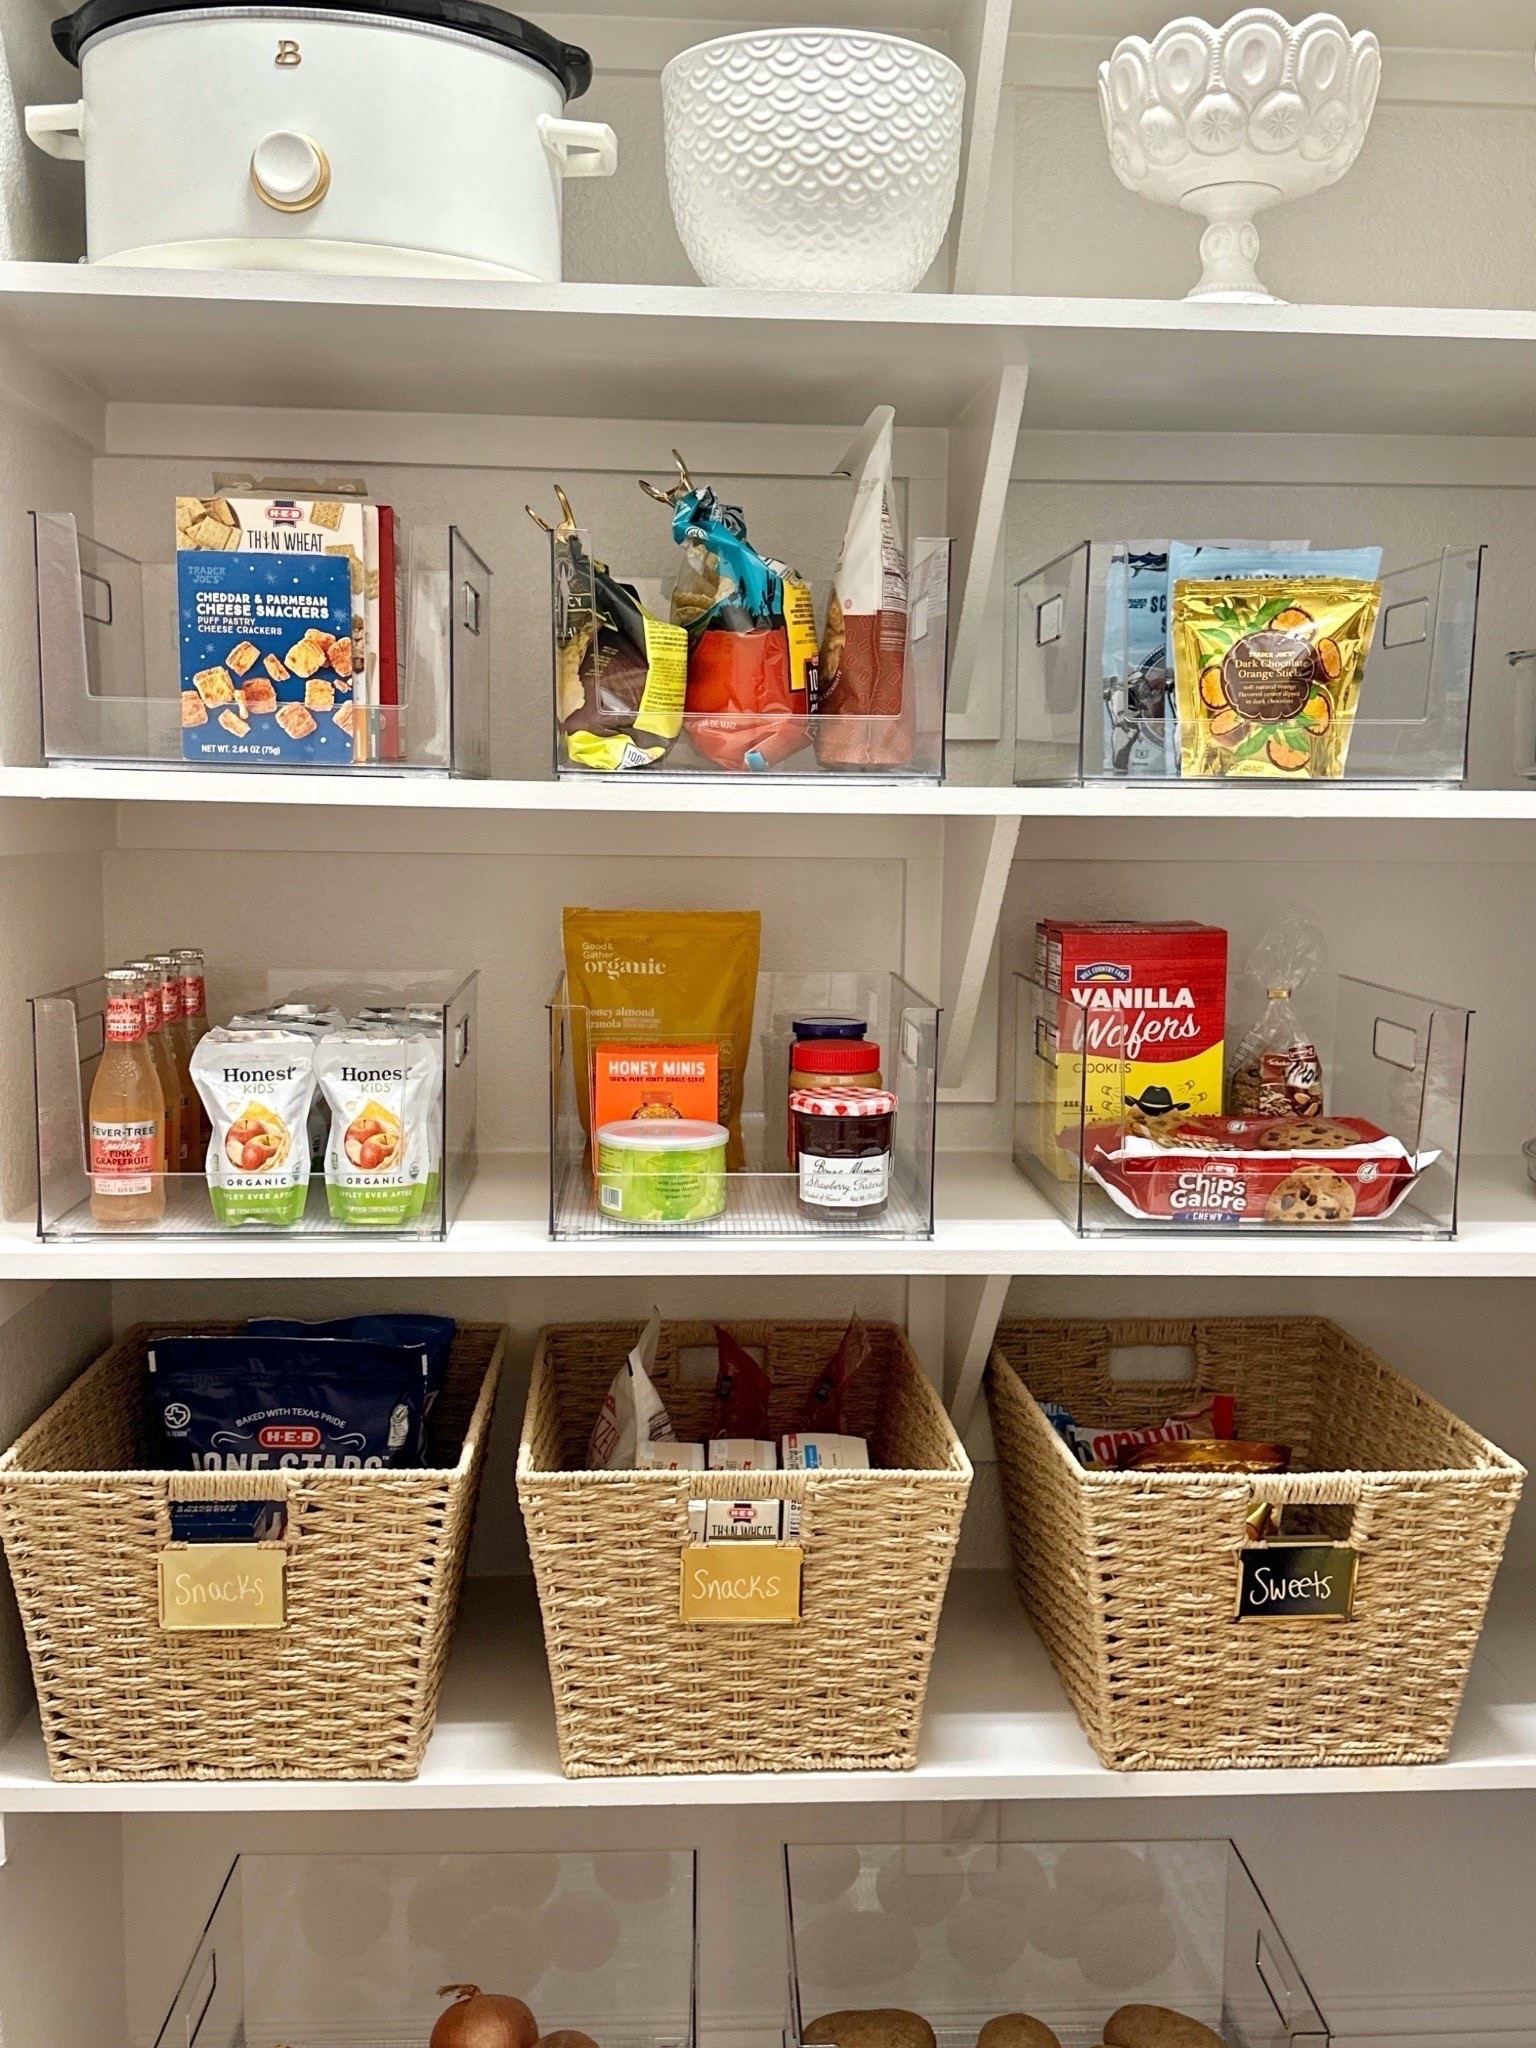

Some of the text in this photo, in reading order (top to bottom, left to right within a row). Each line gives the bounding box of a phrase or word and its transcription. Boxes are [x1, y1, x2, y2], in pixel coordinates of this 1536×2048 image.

[275, 40, 302, 66] B
[284, 532, 323, 552] WHEAT
[188, 566, 226, 575] TRADER
[193, 575, 220, 584] JOE'S
[196, 592, 328, 606] CHEDDAR & PARMESAN
[196, 603, 329, 619] CHEESE SNACKERS
[197, 616, 256, 626] PUFF PASTRY
[197, 625, 283, 635] CHEESE CRACKERS
[1235, 660, 1309, 668] Dark Chocolate
[1238, 669, 1274, 680] Orange
[201, 744, 281, 756] NET WT. 2.64 OZ (75g)
[582, 941, 607, 951] Good
[583, 951, 614, 959] Gather
[584, 958, 666, 980] organic
[1071, 988, 1196, 1009] VANILLA
[590, 1006, 655, 1019] oney almond
[590, 1019, 621, 1029] ranola
[1072, 1010, 1200, 1059] Wafers
[223, 1066, 294, 1083] Honest
[609, 1061, 706, 1076] HONEY MINIS
[92, 1126, 154, 1138] FEVER-TREE
[109, 1150, 132, 1158] PINK
[96, 1156, 149, 1166] GRAPEFRUIT
[227, 1178, 287, 1187] ORGANIC
[346, 1177, 404, 1185] ORGANIC
[1178, 1173, 1246, 1196] Chips
[365, 1191, 388, 1199] EVER
[1170, 1190, 1247, 1211] Galore
[1192, 1212, 1223, 1221] CHEWY
[235, 1408, 347, 1429] BAKED WITH TEXAS PRIDE
[175, 1573, 265, 1606] Snacks
[692, 1569, 782, 1600] Snacks
[1249, 1567, 1333, 1605] Sweets
